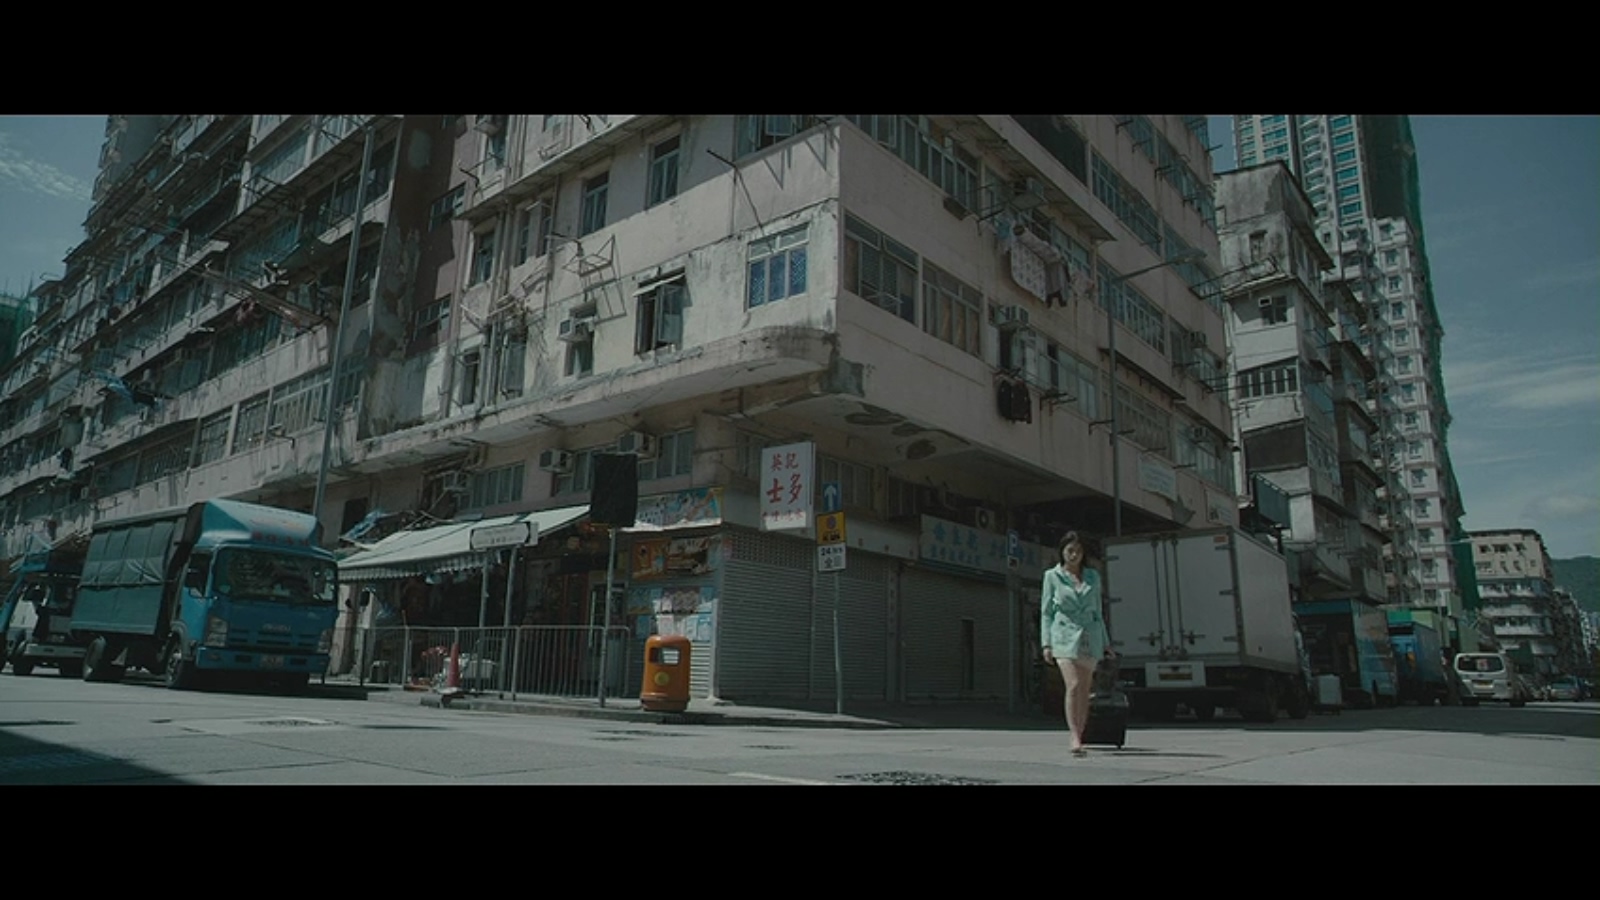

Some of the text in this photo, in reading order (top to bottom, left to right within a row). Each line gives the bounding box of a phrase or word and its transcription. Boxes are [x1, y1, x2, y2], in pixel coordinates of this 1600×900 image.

[766, 473, 802, 505] 士多
[821, 547, 831, 556] 24
[1009, 533, 1018, 554] P
